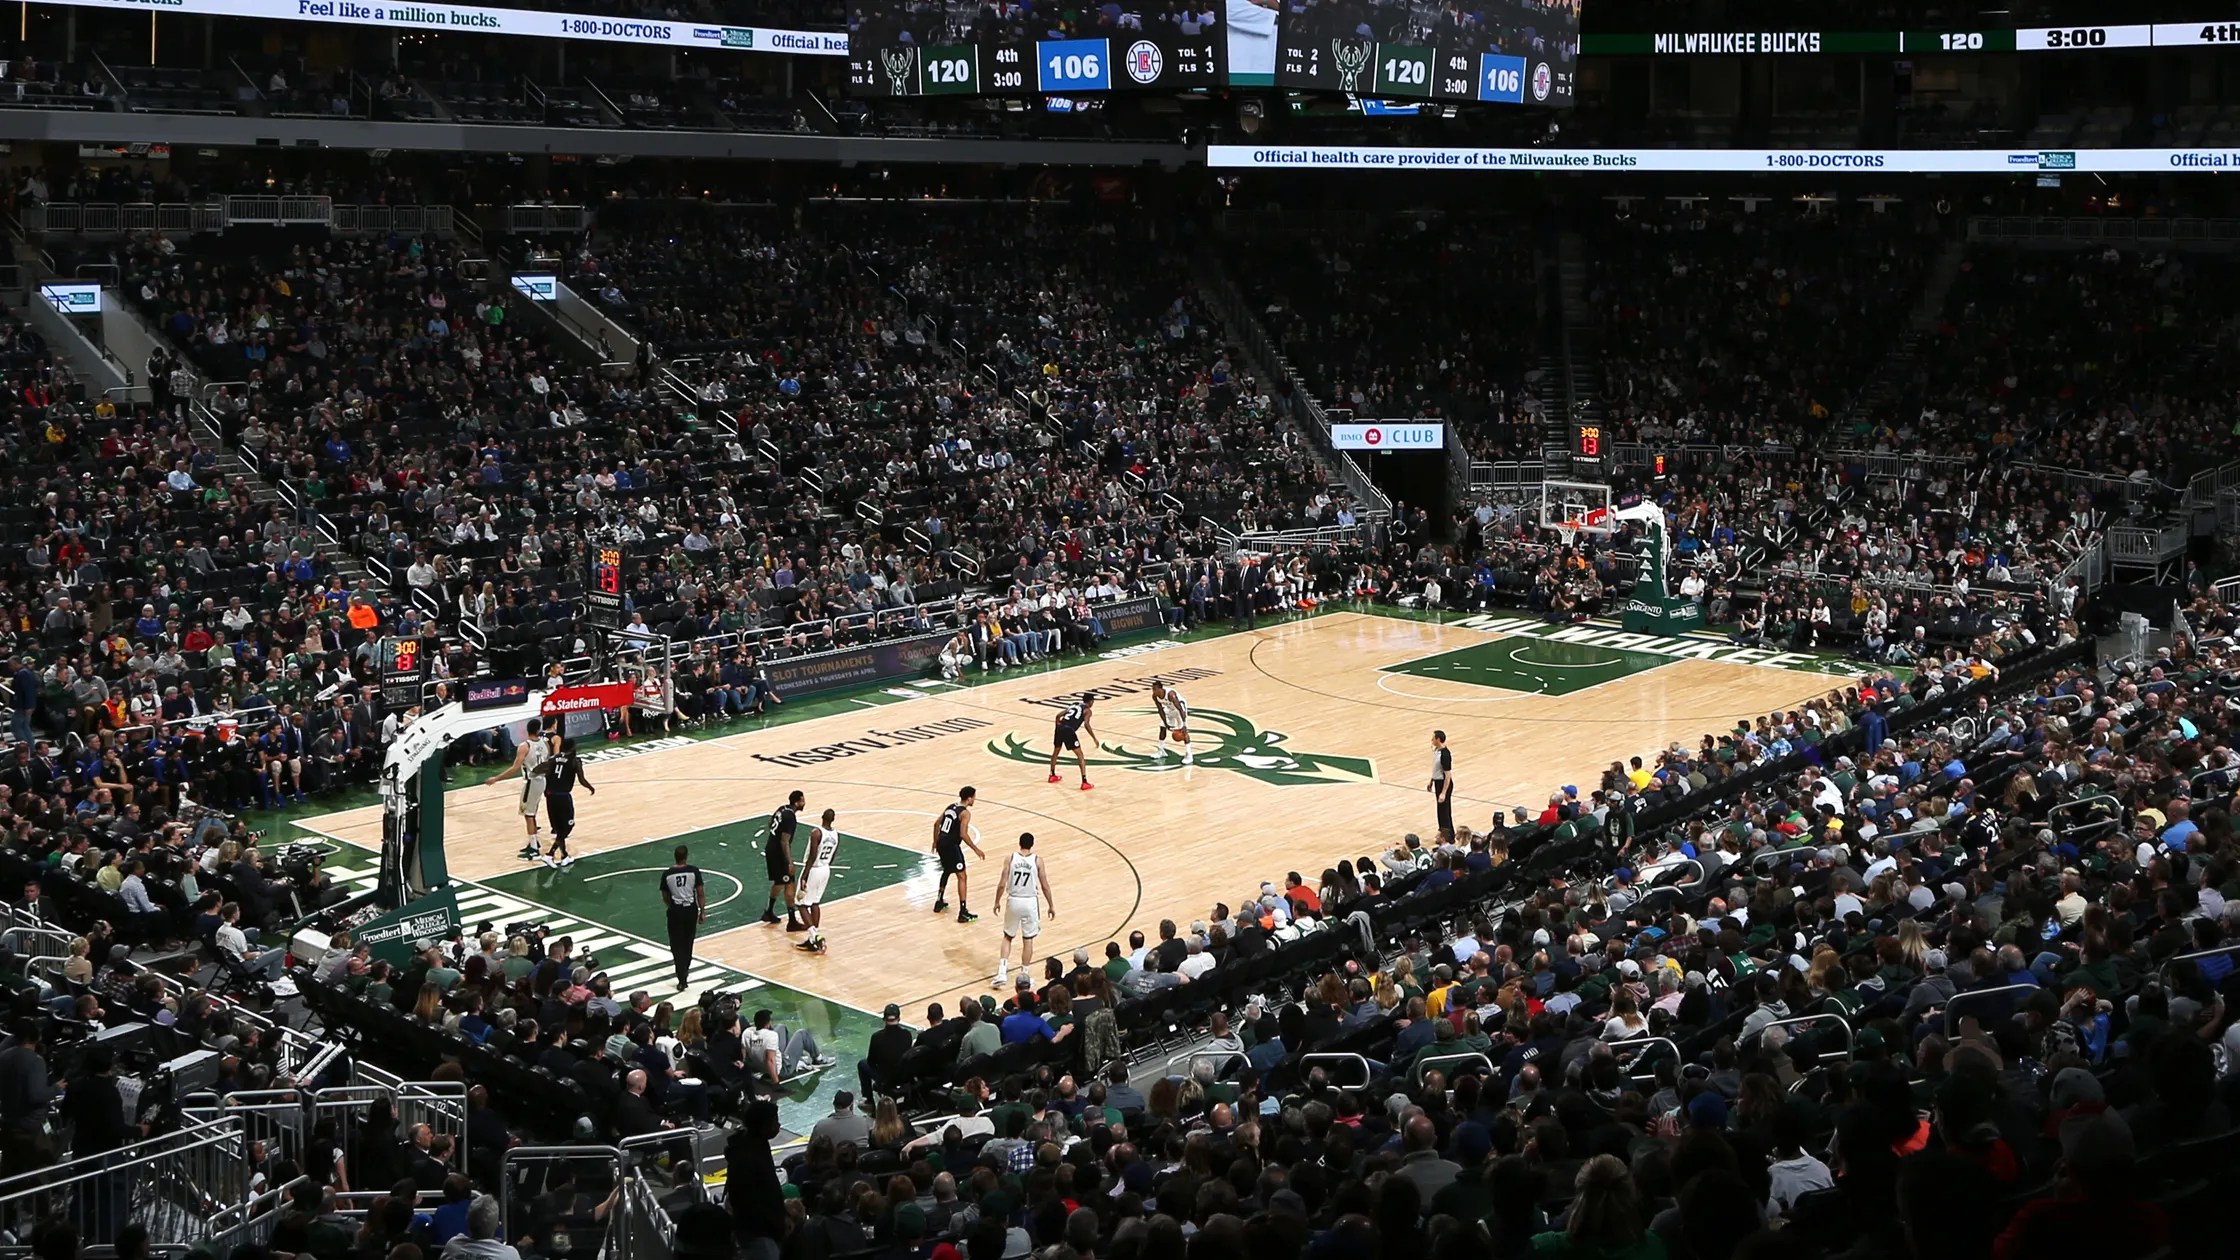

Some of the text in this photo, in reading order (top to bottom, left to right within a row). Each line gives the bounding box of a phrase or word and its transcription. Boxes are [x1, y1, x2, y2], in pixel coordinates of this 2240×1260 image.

[299, 1, 501, 28] Feel like a million bucks.
[561, 19, 671, 39] 1-800-DOCTORS
[772, 34, 819, 50] Official
[1654, 24, 2240, 53] MILWAUKEE BUCKS 120 3:00 4th
[996, 49, 1019, 63] 4th
[1178, 45, 1212, 58] TOL 1
[1287, 48, 1318, 61] TOL 2
[851, 60, 873, 71] TOL 2
[928, 59, 969, 83] 120
[1049, 55, 1100, 79] 106
[1179, 61, 1214, 73] FLS 3
[1286, 63, 1318, 77] FLS 4
[1449, 57, 1467, 71] 4th
[1385, 59, 1425, 84] 120
[867, 73, 874, 85] 4
[993, 73, 1022, 87] 3:00
[1487, 68, 1518, 92] 106
[1445, 79, 1467, 94] 3:00
[1253, 149, 1636, 167] Official health care provider of the Milwaukee Bucks
[1766, 155, 1884, 167] 1-800-DOCTORS
[2170, 154, 2227, 166] Official
[1341, 430, 1433, 442] BMO CLUB
[1581, 427, 1599, 438] 3:00
[1583, 438, 1597, 455] 13
[600, 549, 619, 566] 3:00
[601, 566, 618, 594] 13
[1110, 615, 1144, 630] BIGWIN
[395, 641, 416, 655] 3:00
[1443, 614, 1820, 669] MILWAUKEE
[396, 655, 413, 671] 13
[772, 655, 874, 682] SLOT TOURNAMENTS
[395, 675, 420, 684] TISSOT
[776, 679, 813, 691] WEDNESDAYS
[555, 765, 563, 778] 4
[941, 817, 953, 834] 10
[676, 875, 687, 888] 27
[1014, 871, 1031, 887] 77
[411, 921, 439, 932] COLLEGE
[414, 914, 444, 926] MEDICAL
[362, 927, 401, 942] Froedtert
[412, 925, 448, 938] WISCONSIN
